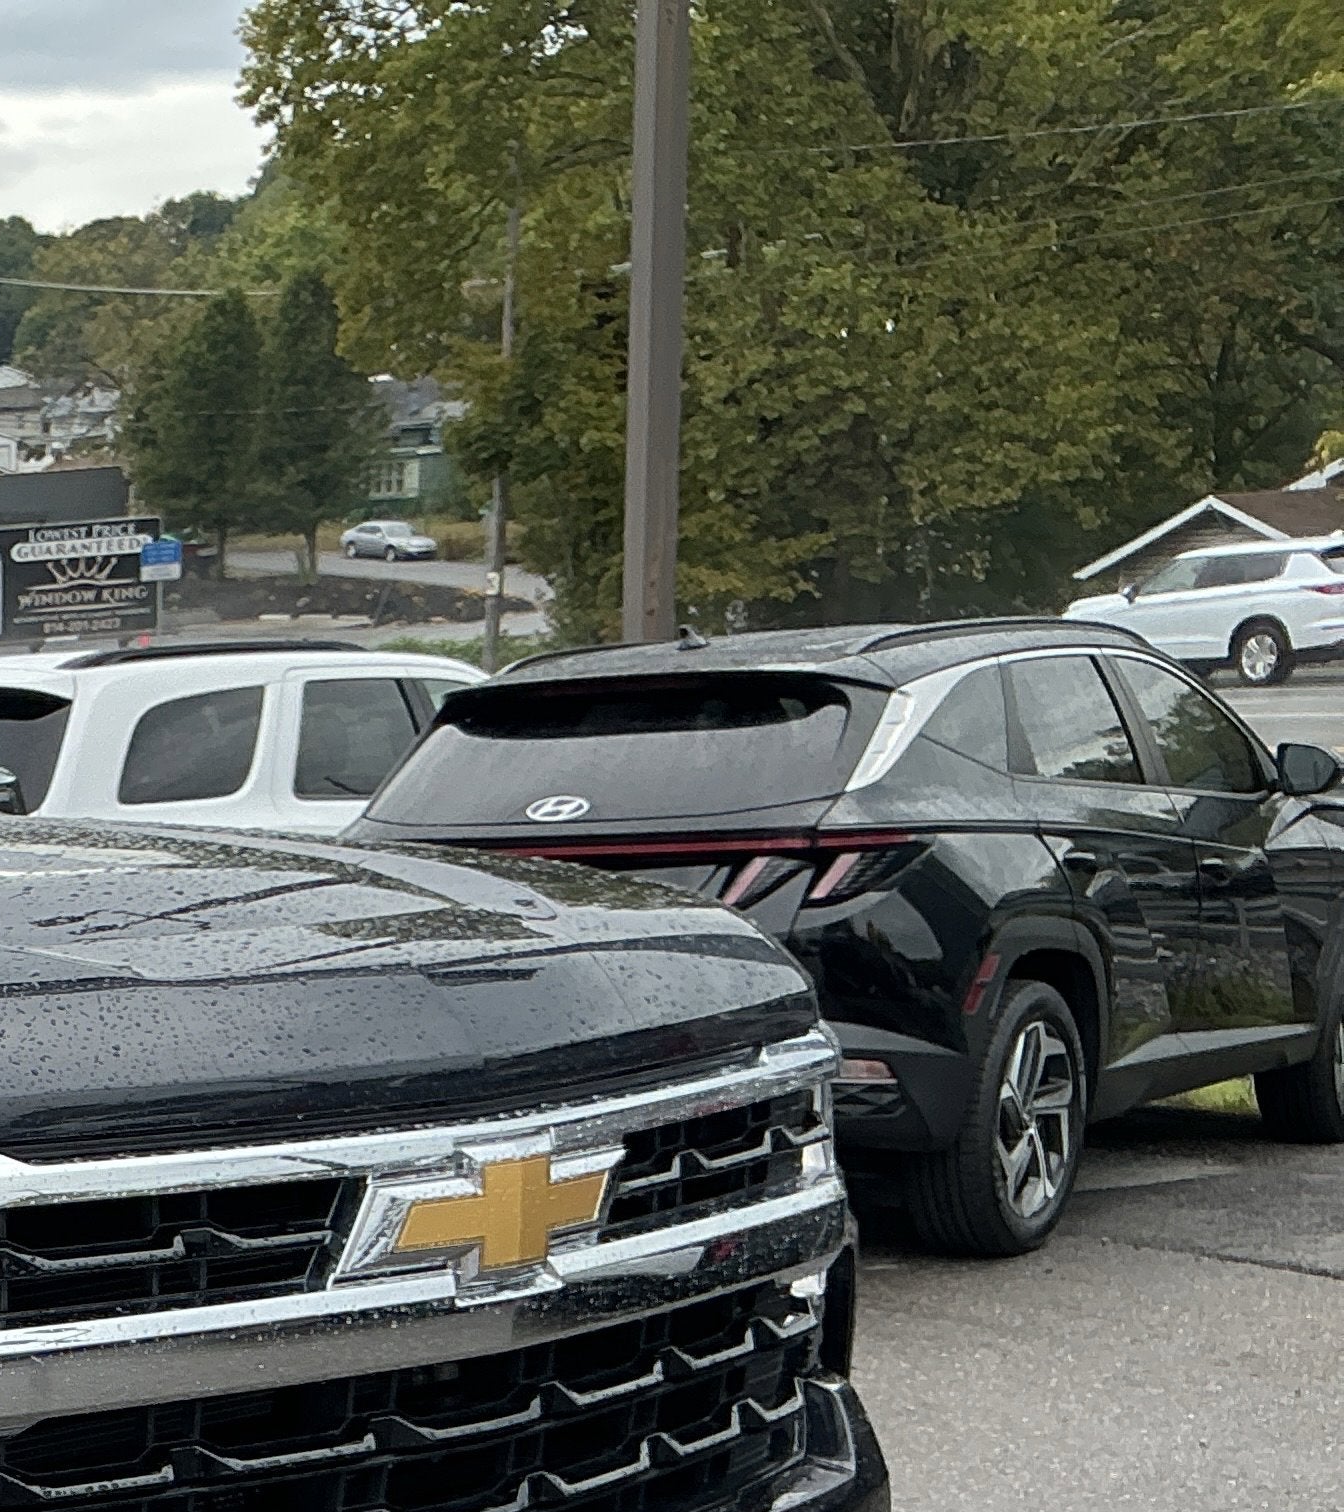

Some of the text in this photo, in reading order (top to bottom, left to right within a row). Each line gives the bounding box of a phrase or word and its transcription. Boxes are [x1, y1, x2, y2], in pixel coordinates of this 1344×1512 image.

[92, 522, 137, 539] PRICE
[17, 585, 149, 610] WINDOW KING
